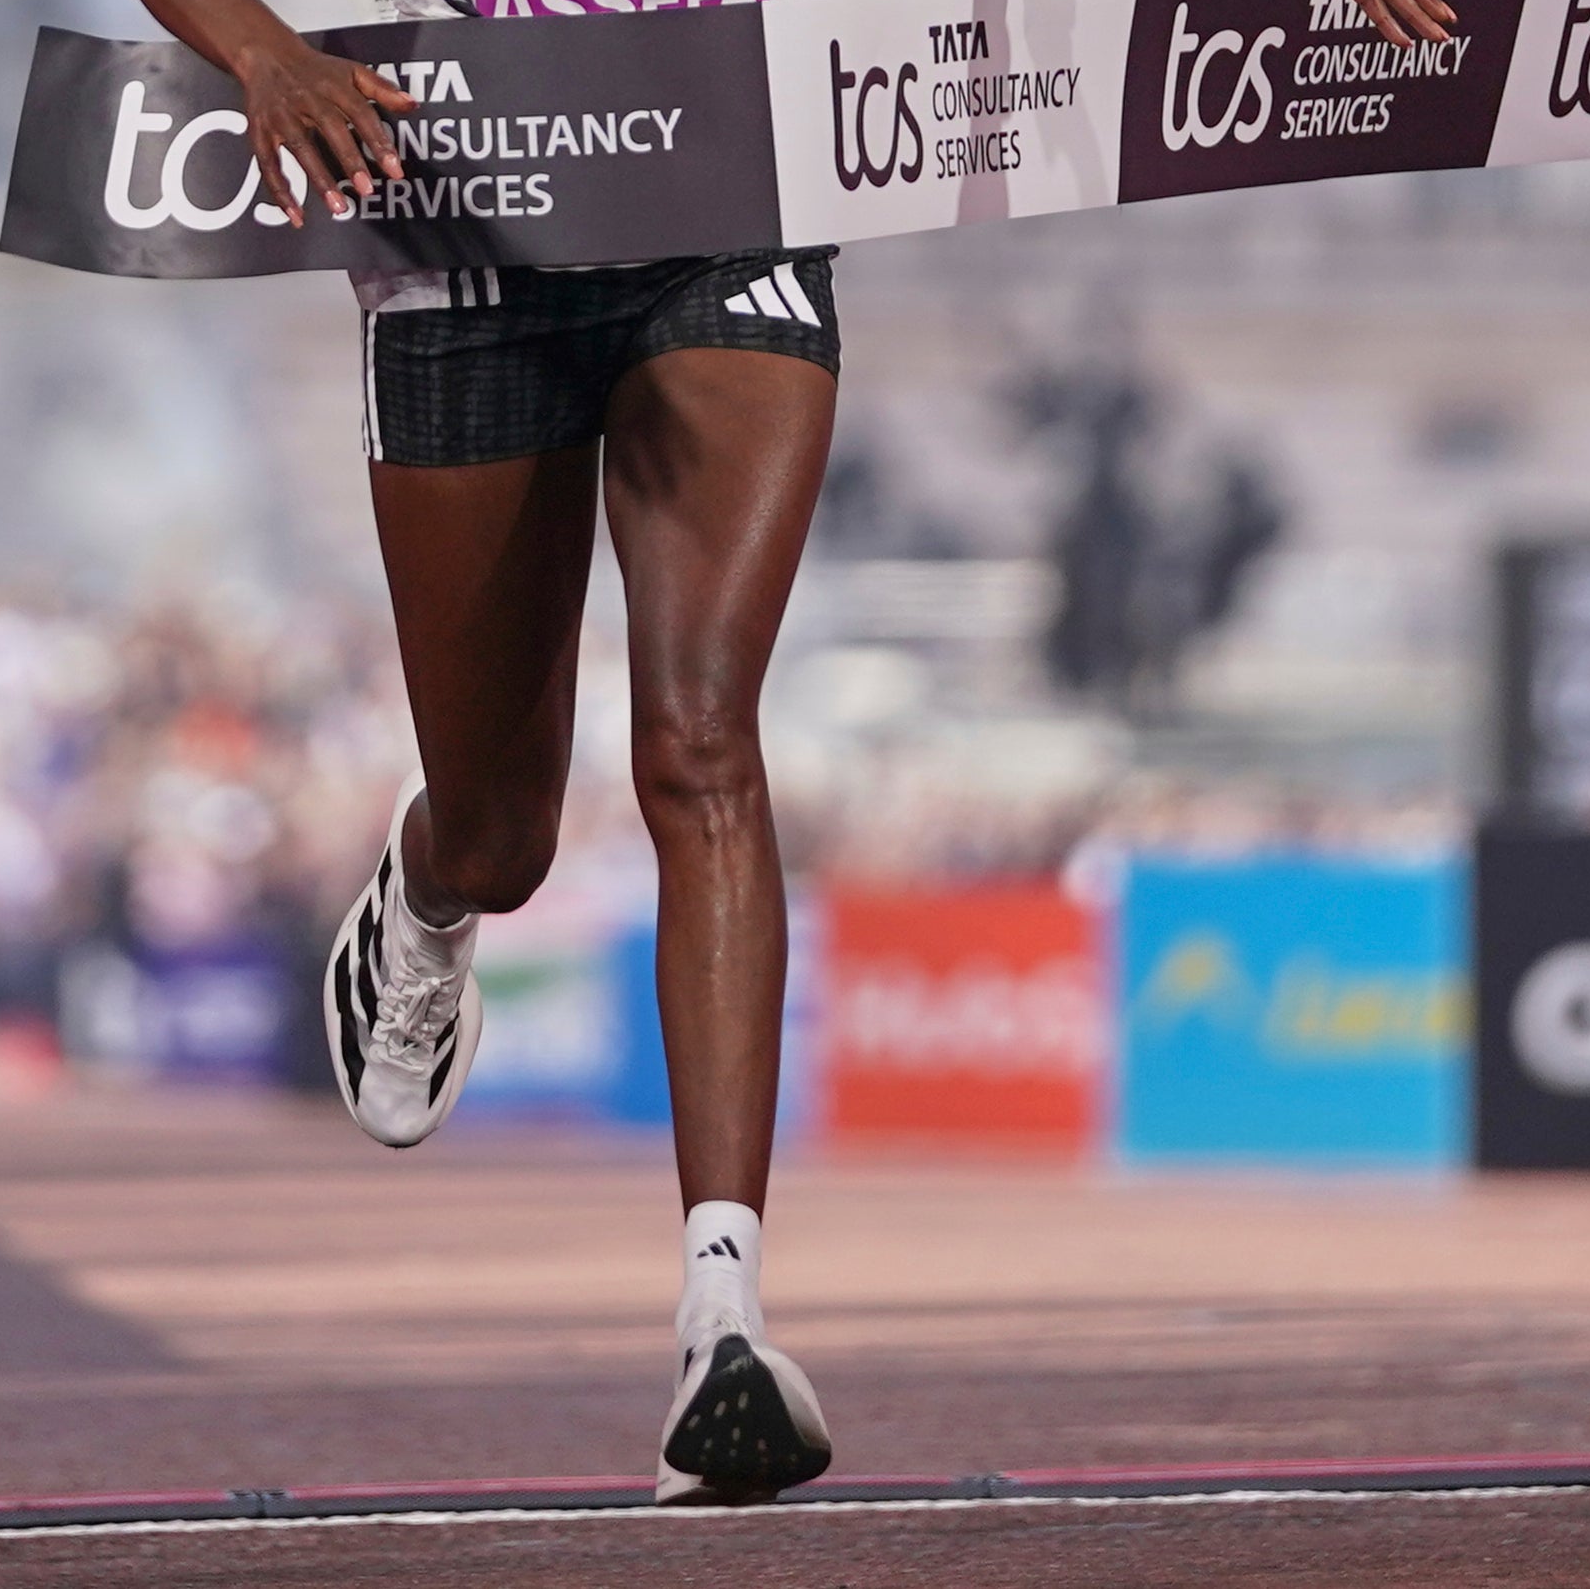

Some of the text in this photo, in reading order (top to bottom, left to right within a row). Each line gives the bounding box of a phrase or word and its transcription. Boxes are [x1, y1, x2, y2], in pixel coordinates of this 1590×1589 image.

[928, 20, 990, 65] TATA
[1161, 1, 1472, 152] tcs CONSULTANCY
[829, 38, 1082, 192] tcs CONSULTANCY
[1280, 93, 1395, 140] SERVICES
[935, 129, 1022, 180] SERVICES
